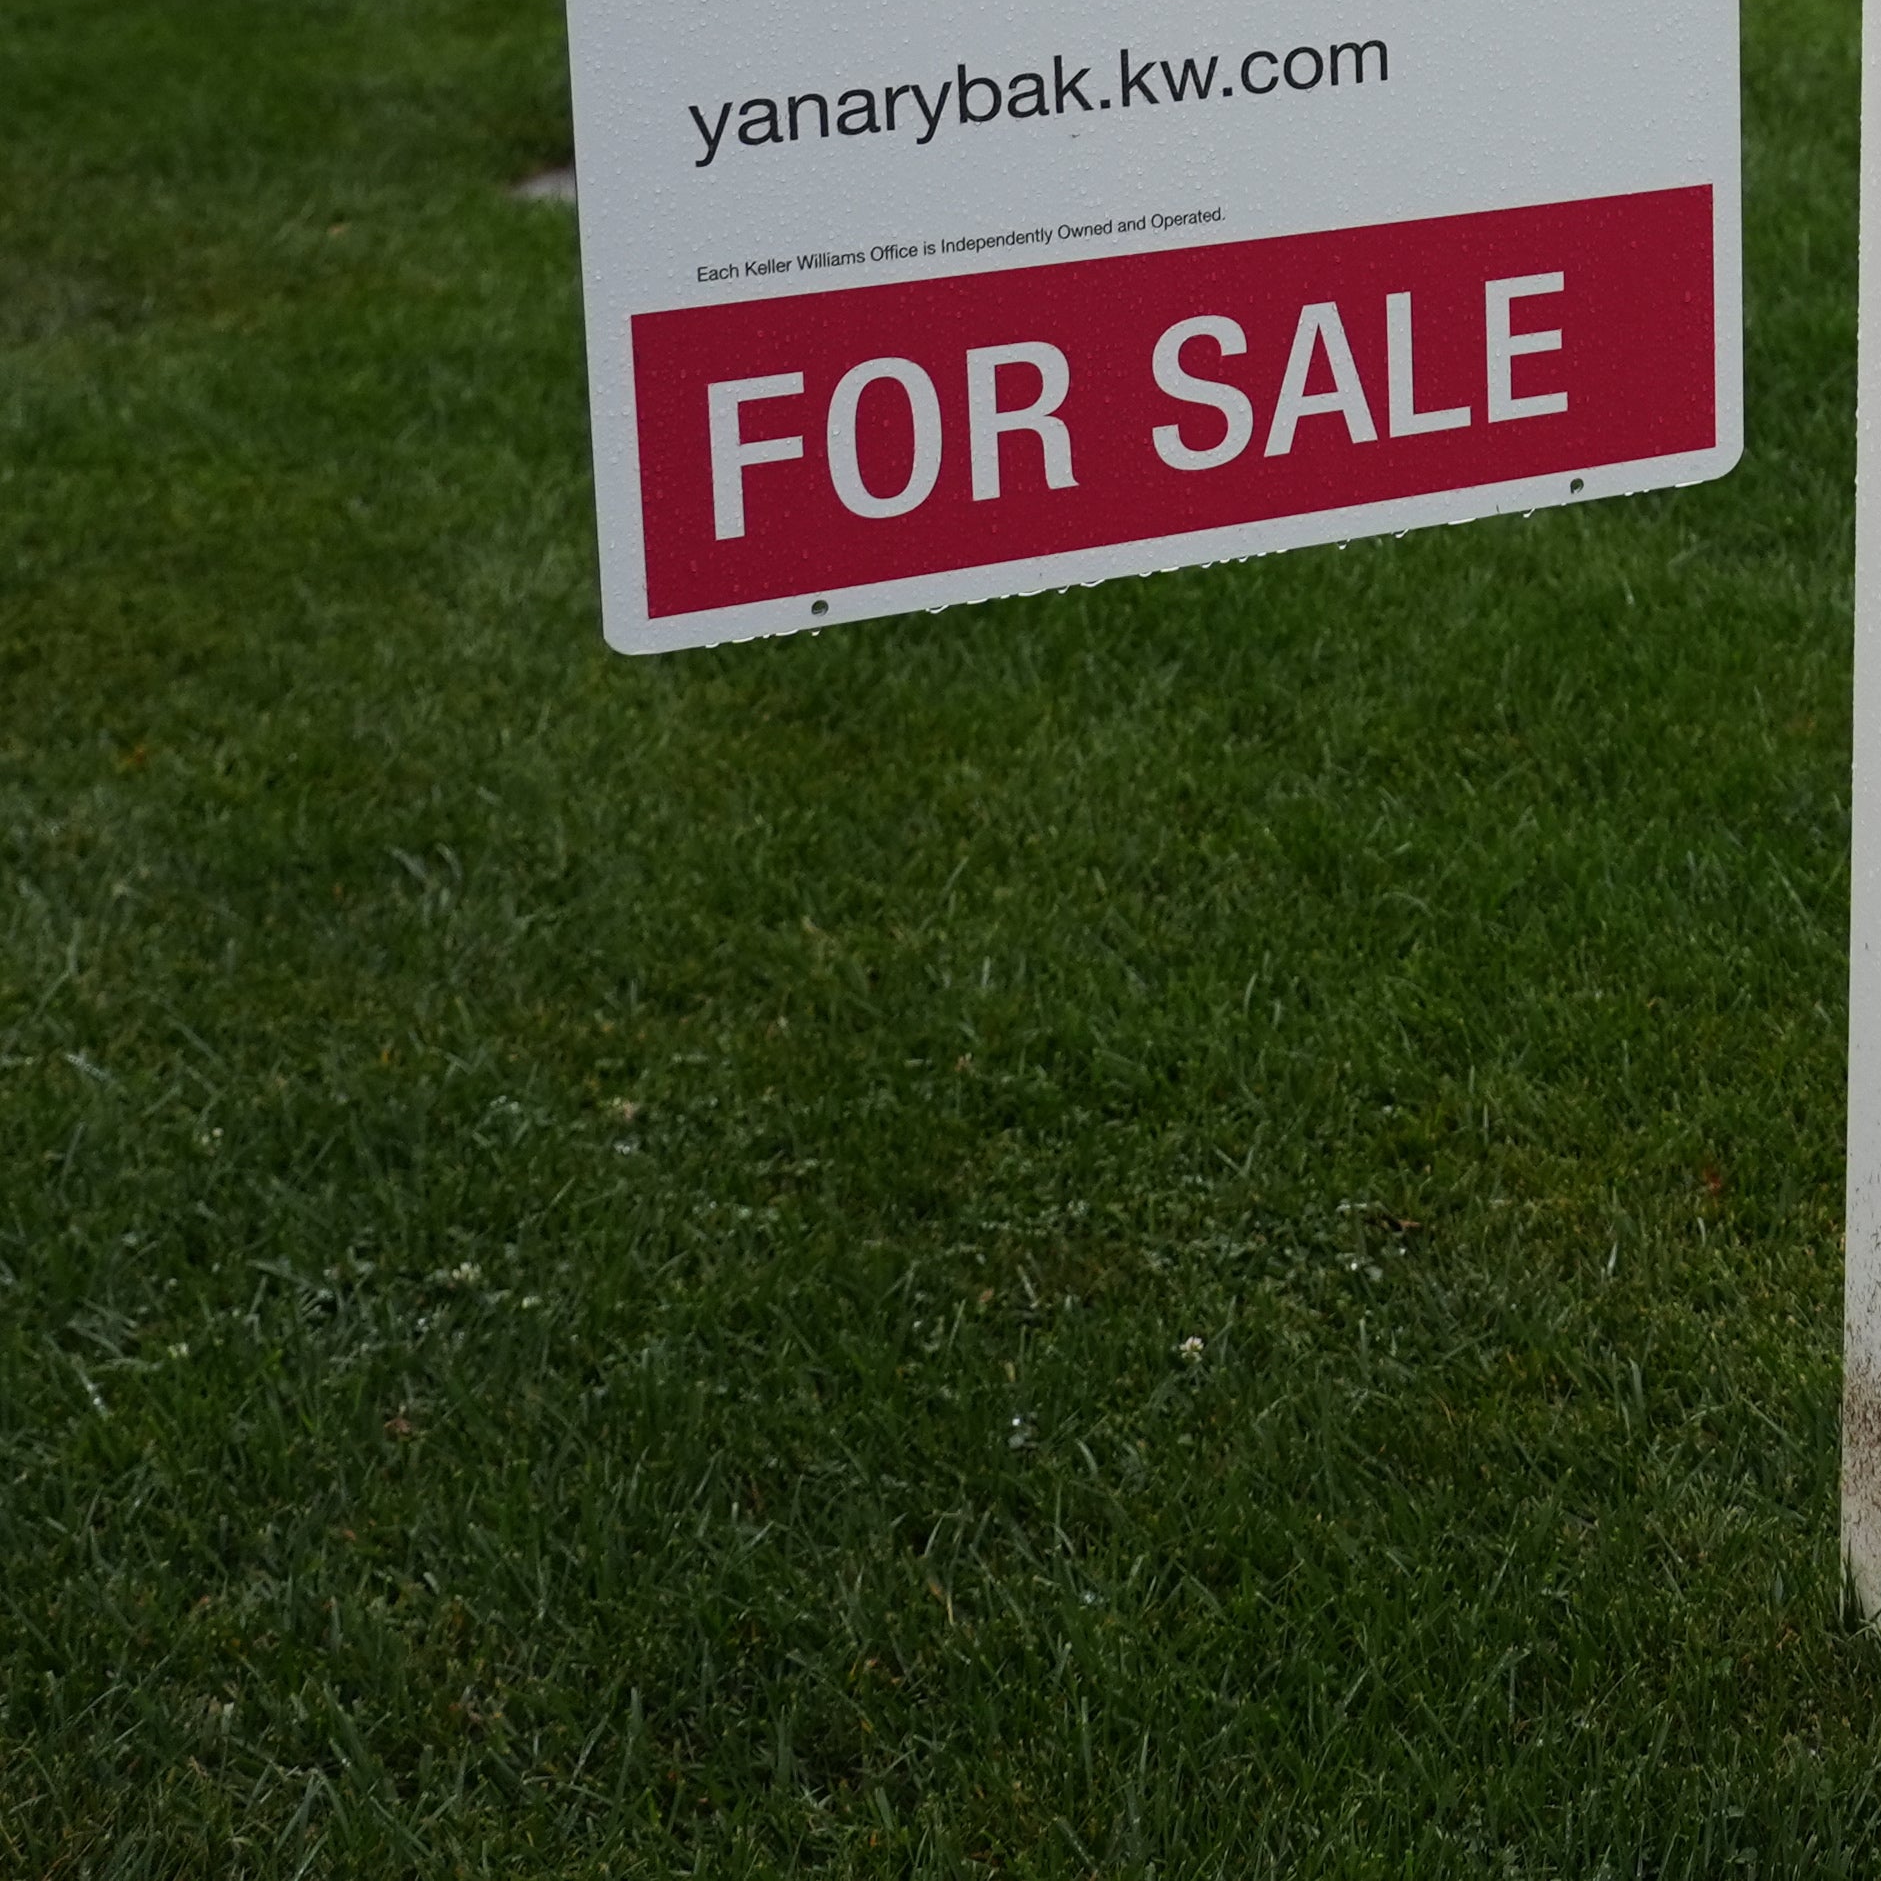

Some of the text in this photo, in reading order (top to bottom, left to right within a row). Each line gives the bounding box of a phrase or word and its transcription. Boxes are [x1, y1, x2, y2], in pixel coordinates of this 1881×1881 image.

[687, 39, 1388, 168] yanarybak.kw.com
[696, 206, 1227, 284] Each Keller Williams Office is Independently Owned and Operated.
[707, 271, 1570, 542] FOR SALE
